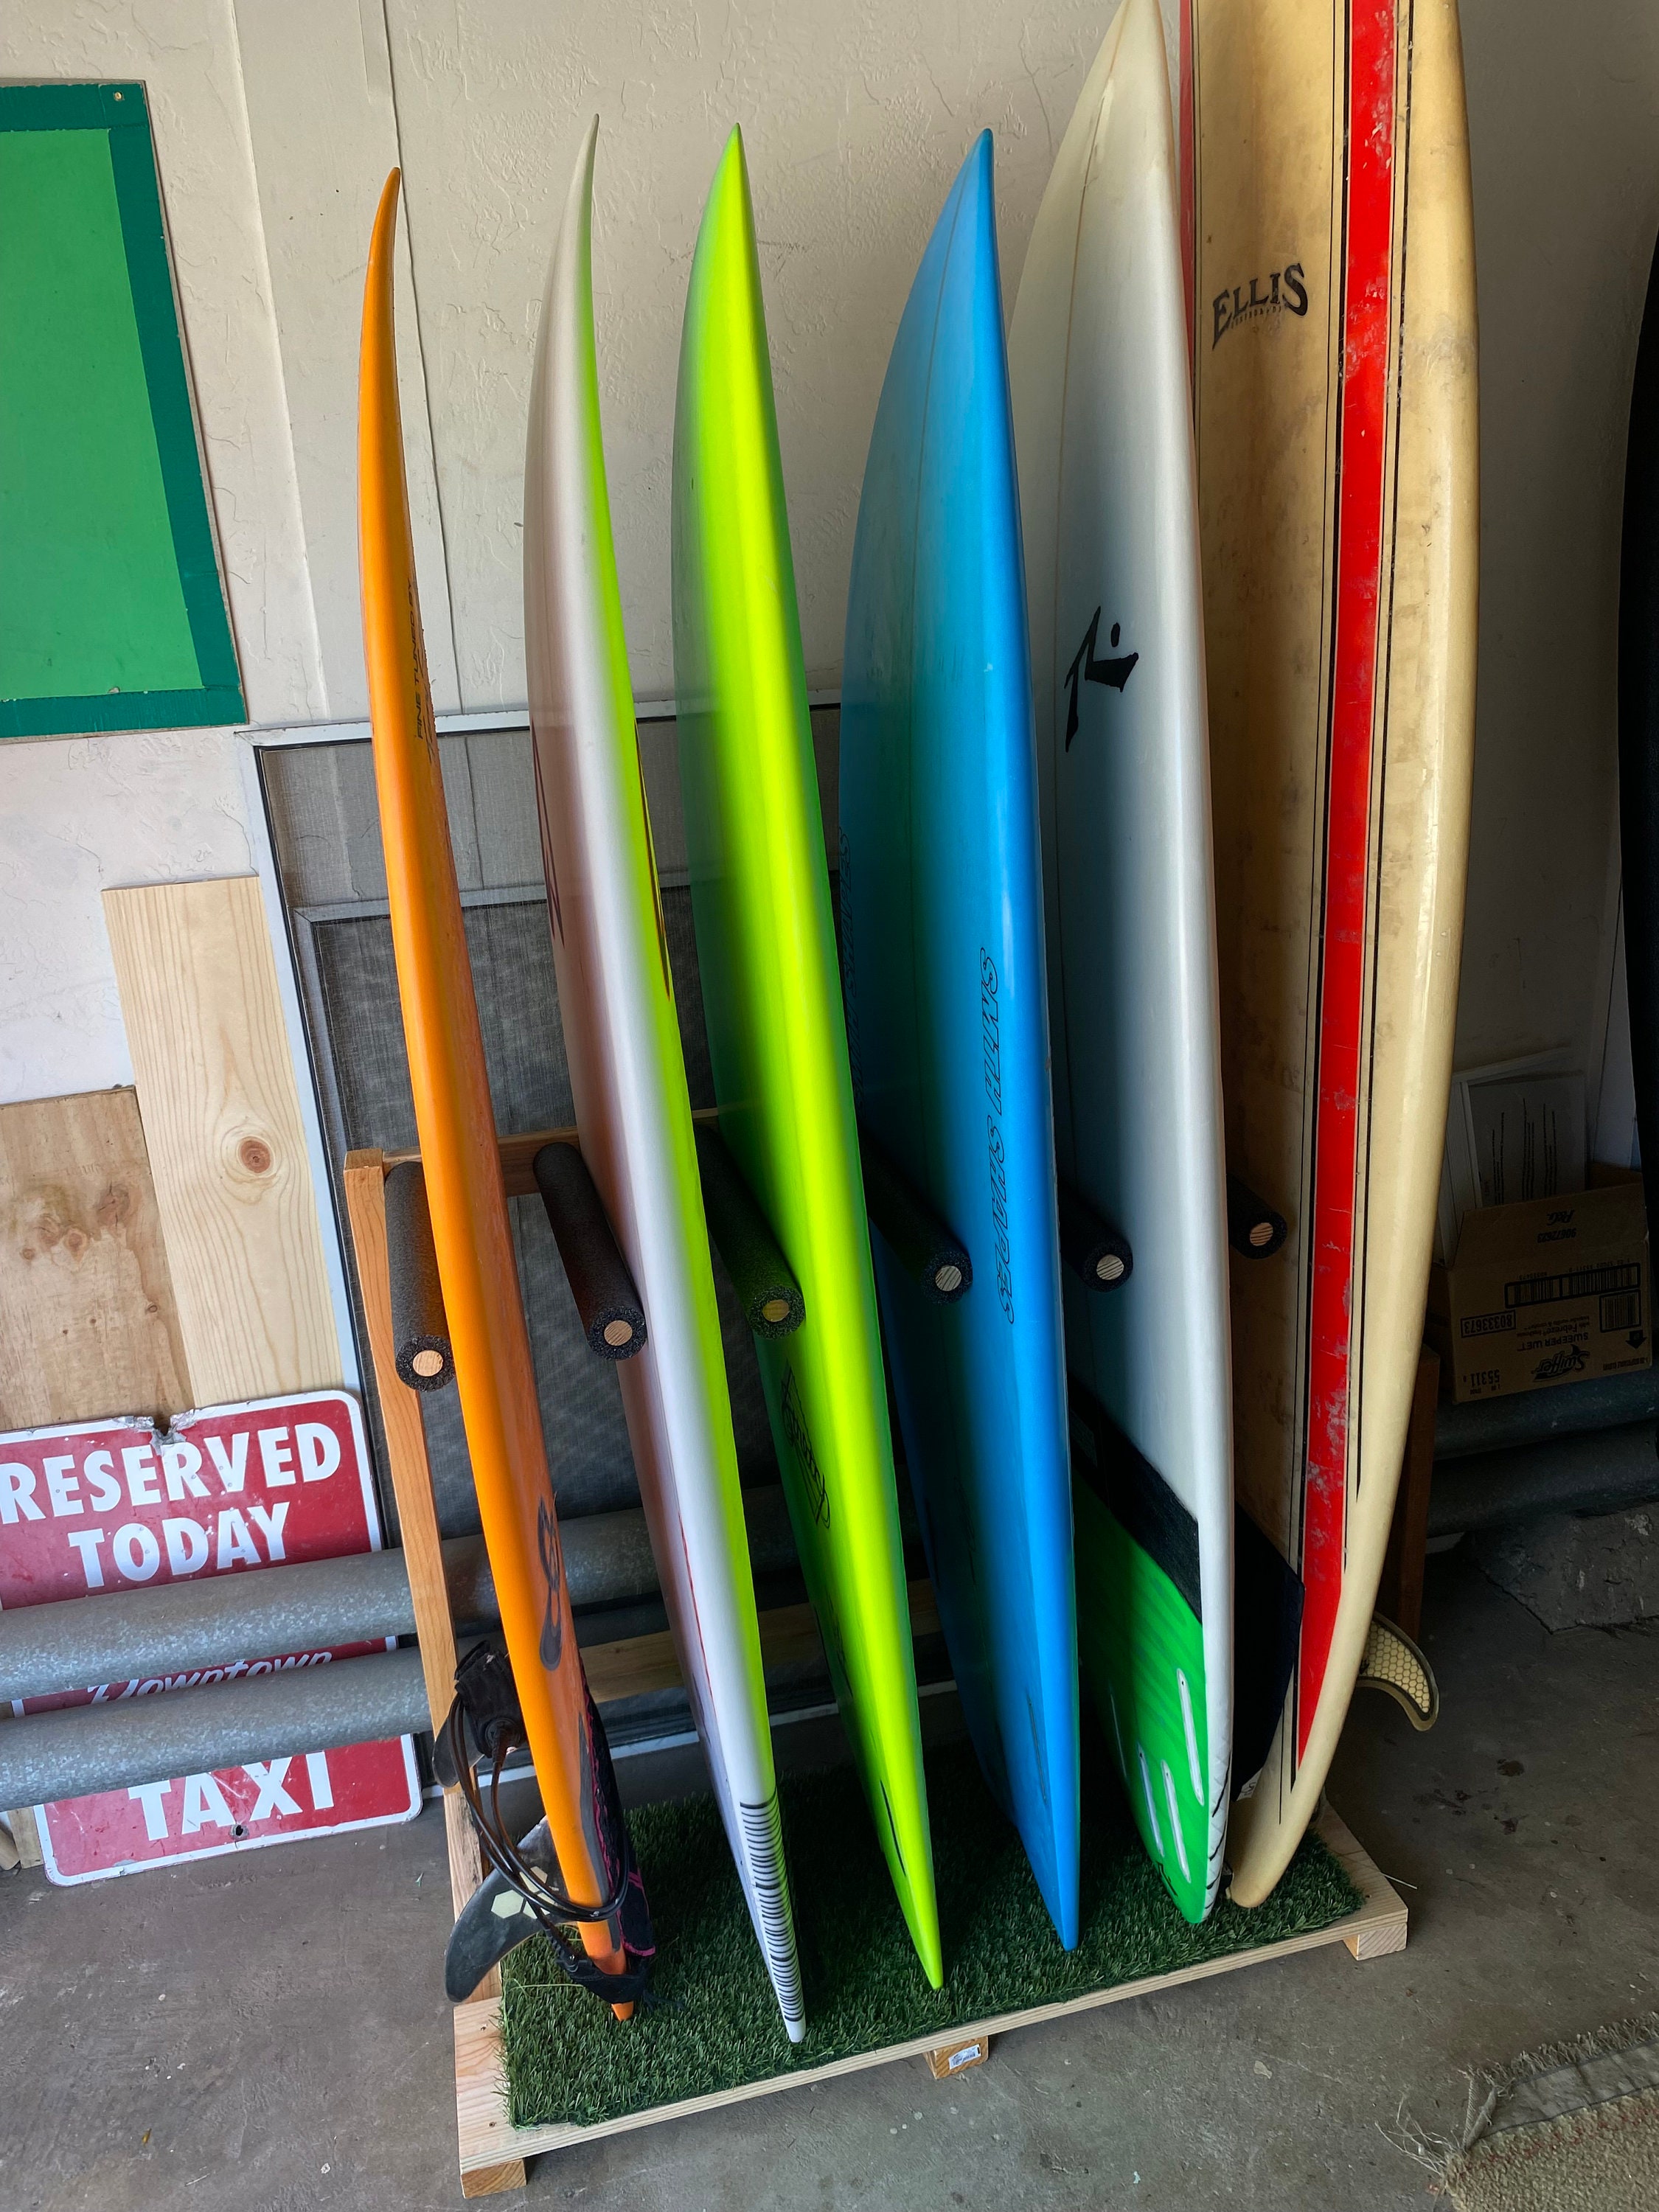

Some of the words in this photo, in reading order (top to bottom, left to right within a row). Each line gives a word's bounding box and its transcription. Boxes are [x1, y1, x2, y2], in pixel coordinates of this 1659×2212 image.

[1211, 262, 1308, 351] ELLIS
[407, 577, 414, 607] BY
[410, 611, 420, 686] TUNED
[414, 692, 422, 740] FINE
[987, 1115, 1014, 1324] SHAPES
[1464, 1314, 1512, 1335] 80333673
[1517, 1340, 1543, 1352] WET
[1544, 1332, 1589, 1346] SWEEPER
[1471, 1369, 1500, 1388] 55311
[0, 1422, 341, 1524] RESERVED
[68, 1502, 290, 1588] TODAY
[128, 1751, 334, 1841] TAXI
